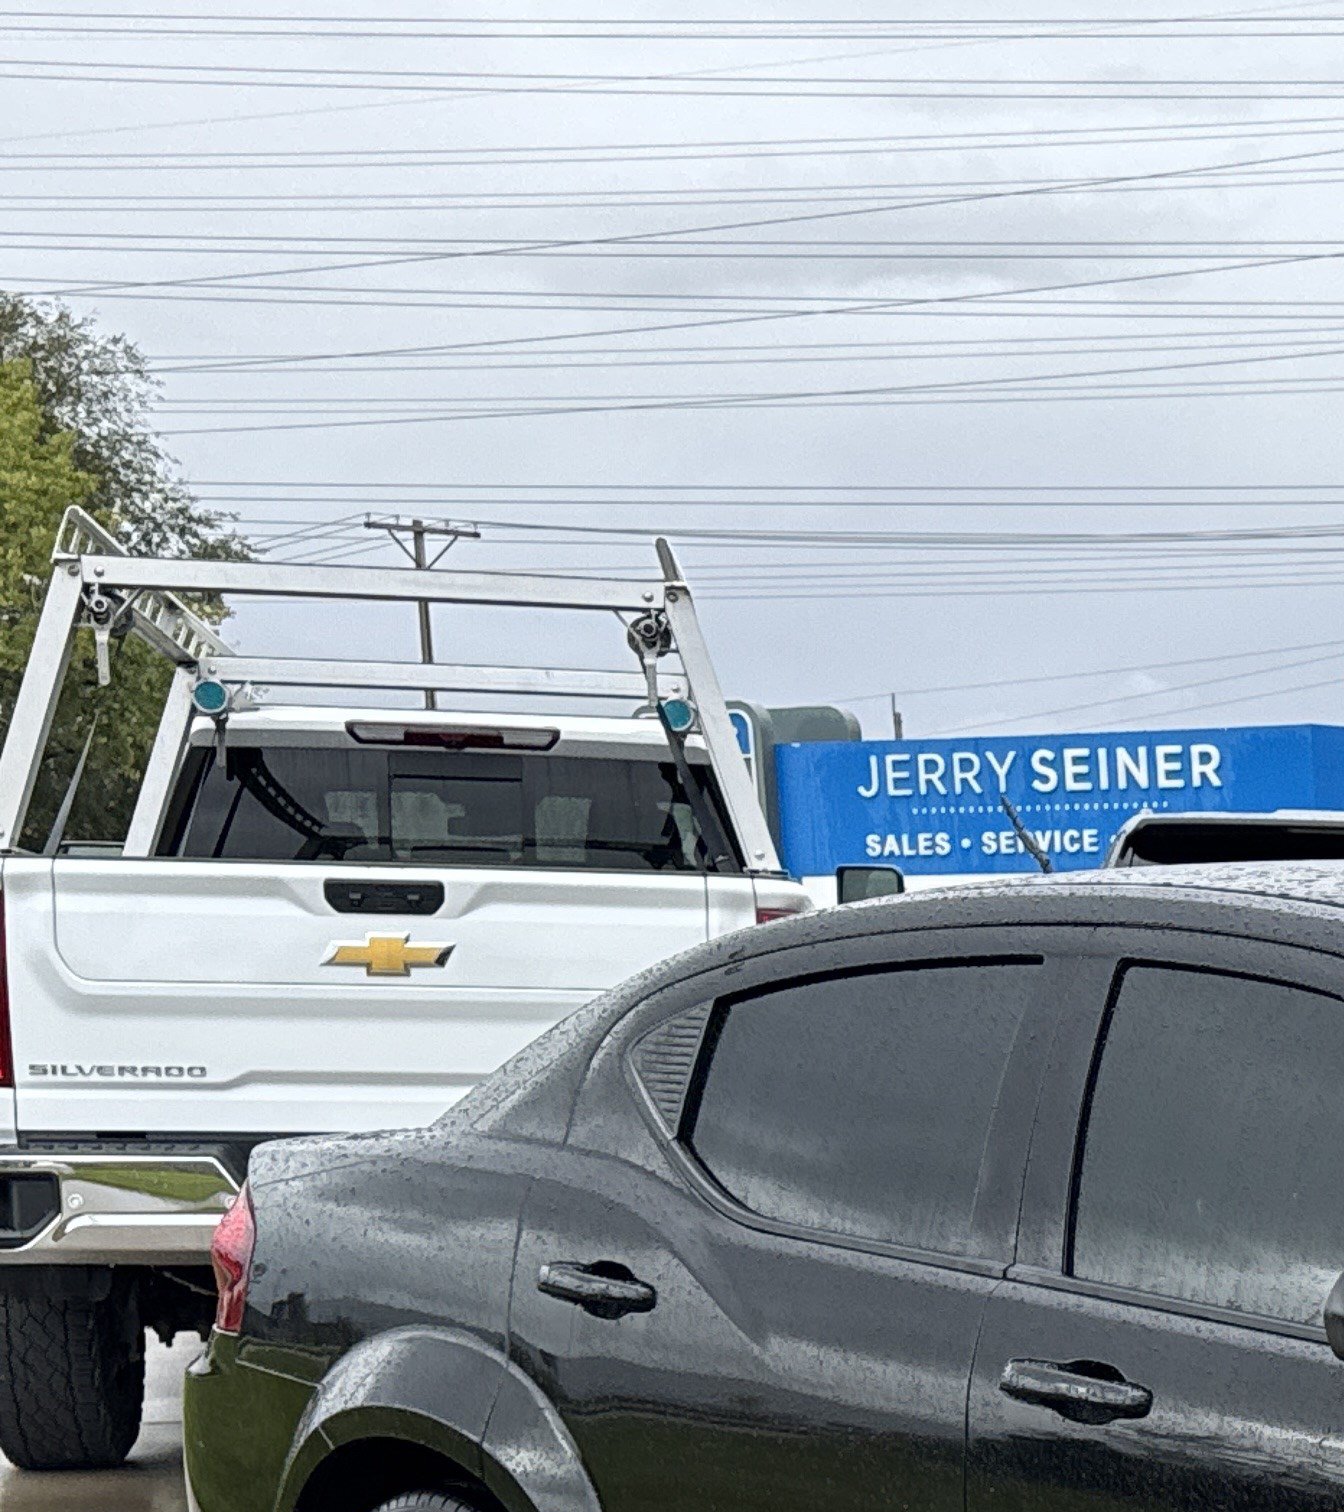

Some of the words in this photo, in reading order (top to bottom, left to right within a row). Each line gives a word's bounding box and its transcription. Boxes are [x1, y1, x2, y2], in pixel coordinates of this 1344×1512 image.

[857, 750, 1017, 798] JERRY
[1030, 743, 1223, 794] SEINER
[865, 831, 952, 858] SALES
[28, 1063, 208, 1078] SILVERADO
